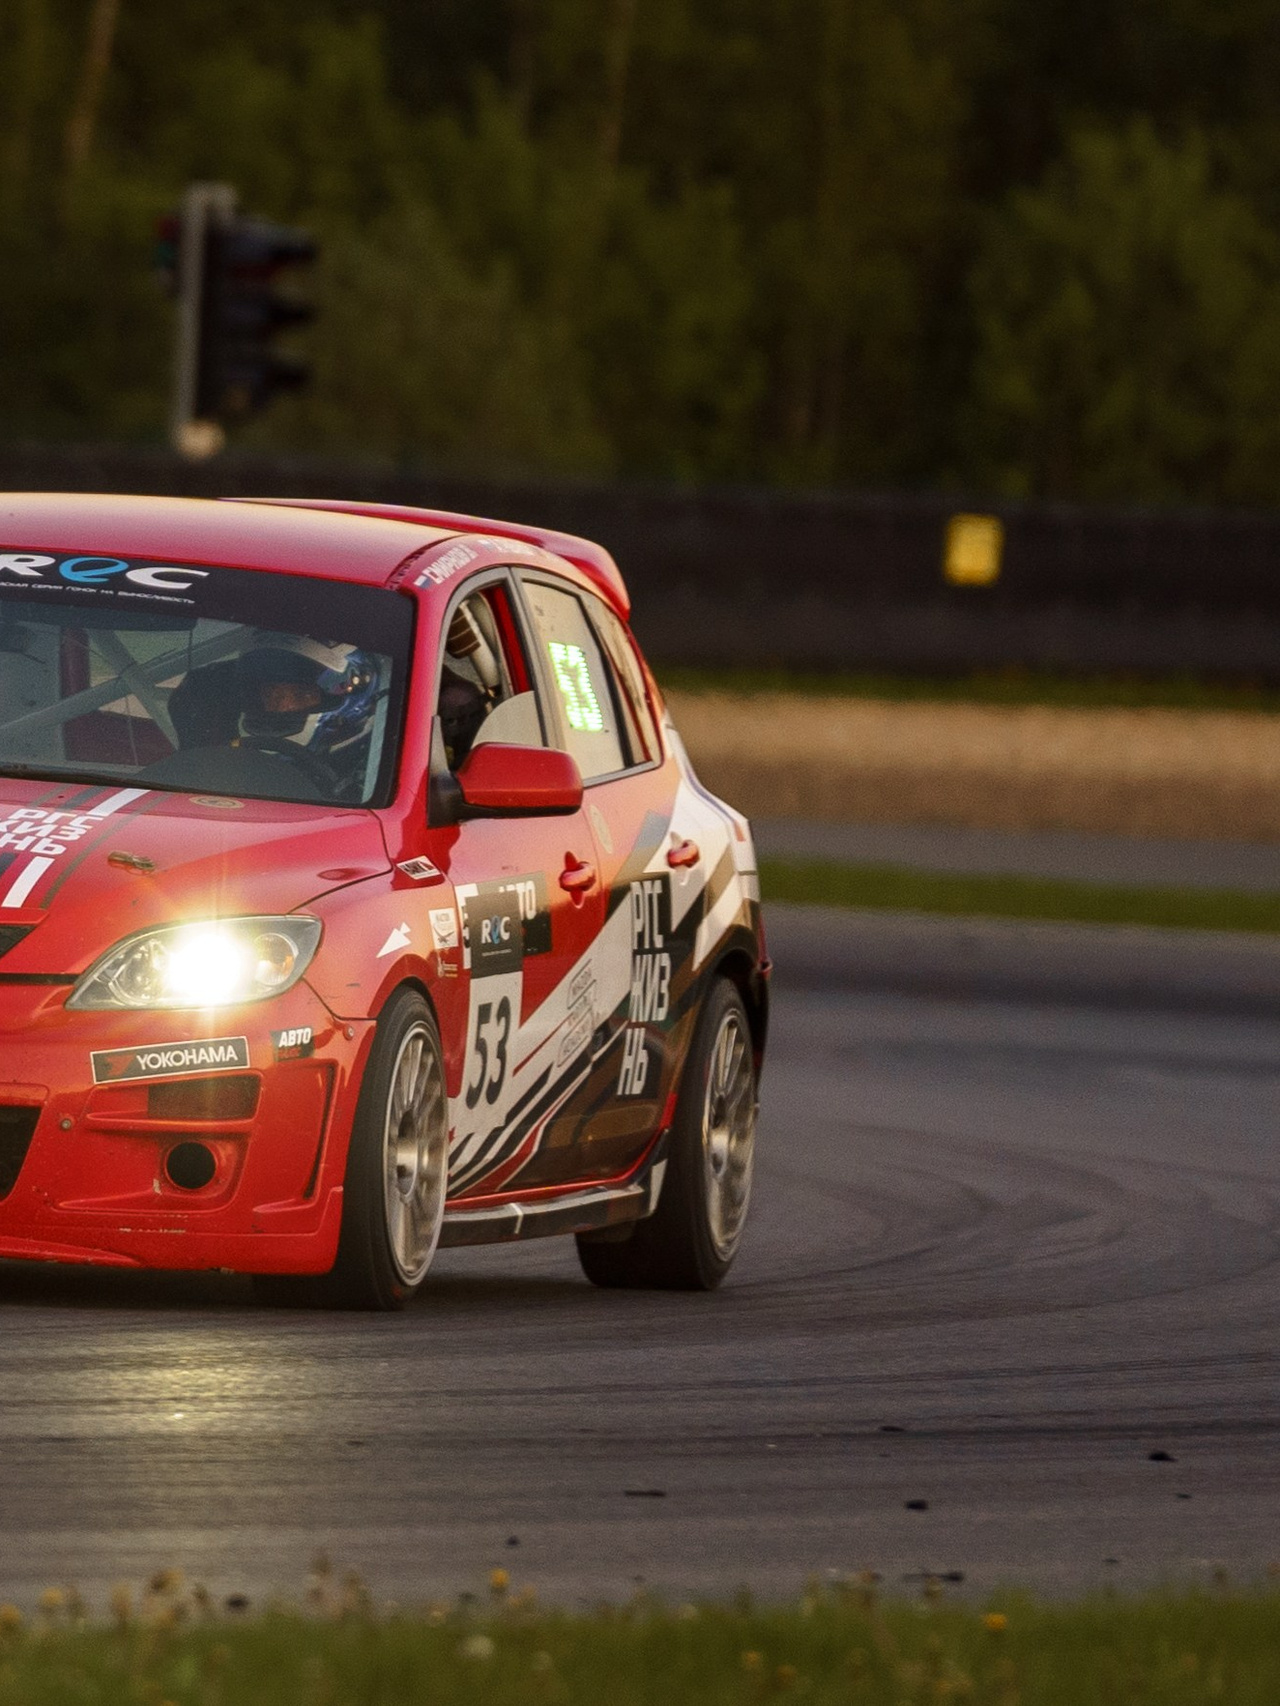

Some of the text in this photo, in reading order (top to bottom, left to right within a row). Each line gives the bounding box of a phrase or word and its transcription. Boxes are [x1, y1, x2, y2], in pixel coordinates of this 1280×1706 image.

[8, 808, 104, 829] РГС
[630, 879, 664, 950] РГС
[630, 952, 671, 1023] ЖИЗ
[136, 1044, 238, 1071] YOKOHAMA
[465, 995, 511, 1110] 53
[617, 1027, 649, 1096] НЬ
